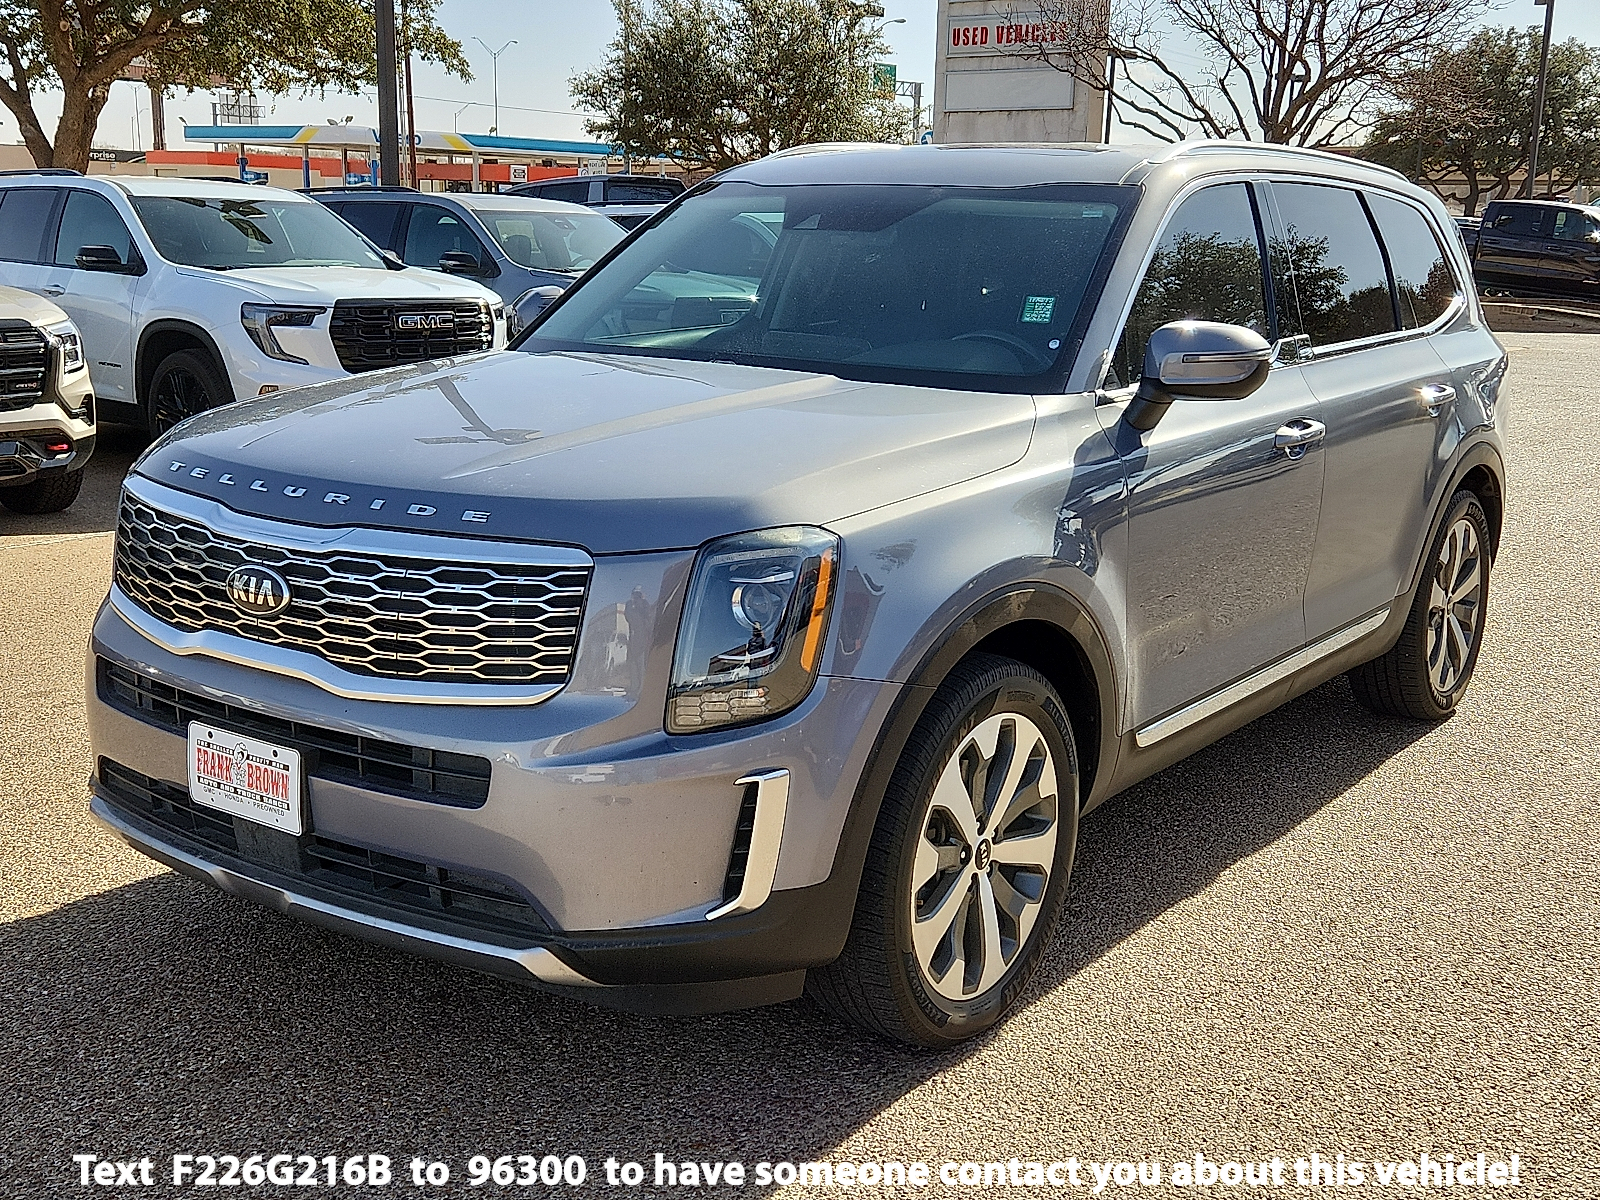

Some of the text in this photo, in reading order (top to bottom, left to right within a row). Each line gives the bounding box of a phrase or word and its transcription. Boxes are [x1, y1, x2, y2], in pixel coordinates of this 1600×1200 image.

[952, 26, 989, 46] USED
[398, 314, 454, 329] GMC
[169, 459, 492, 524] TELLURIDE
[232, 573, 276, 607] KIA
[196, 747, 290, 801] FRANK BROWN
[199, 776, 288, 810] AUTO AND TRUCK RANCH
[203, 786, 285, 817] GMC HONDA PREOWNED
